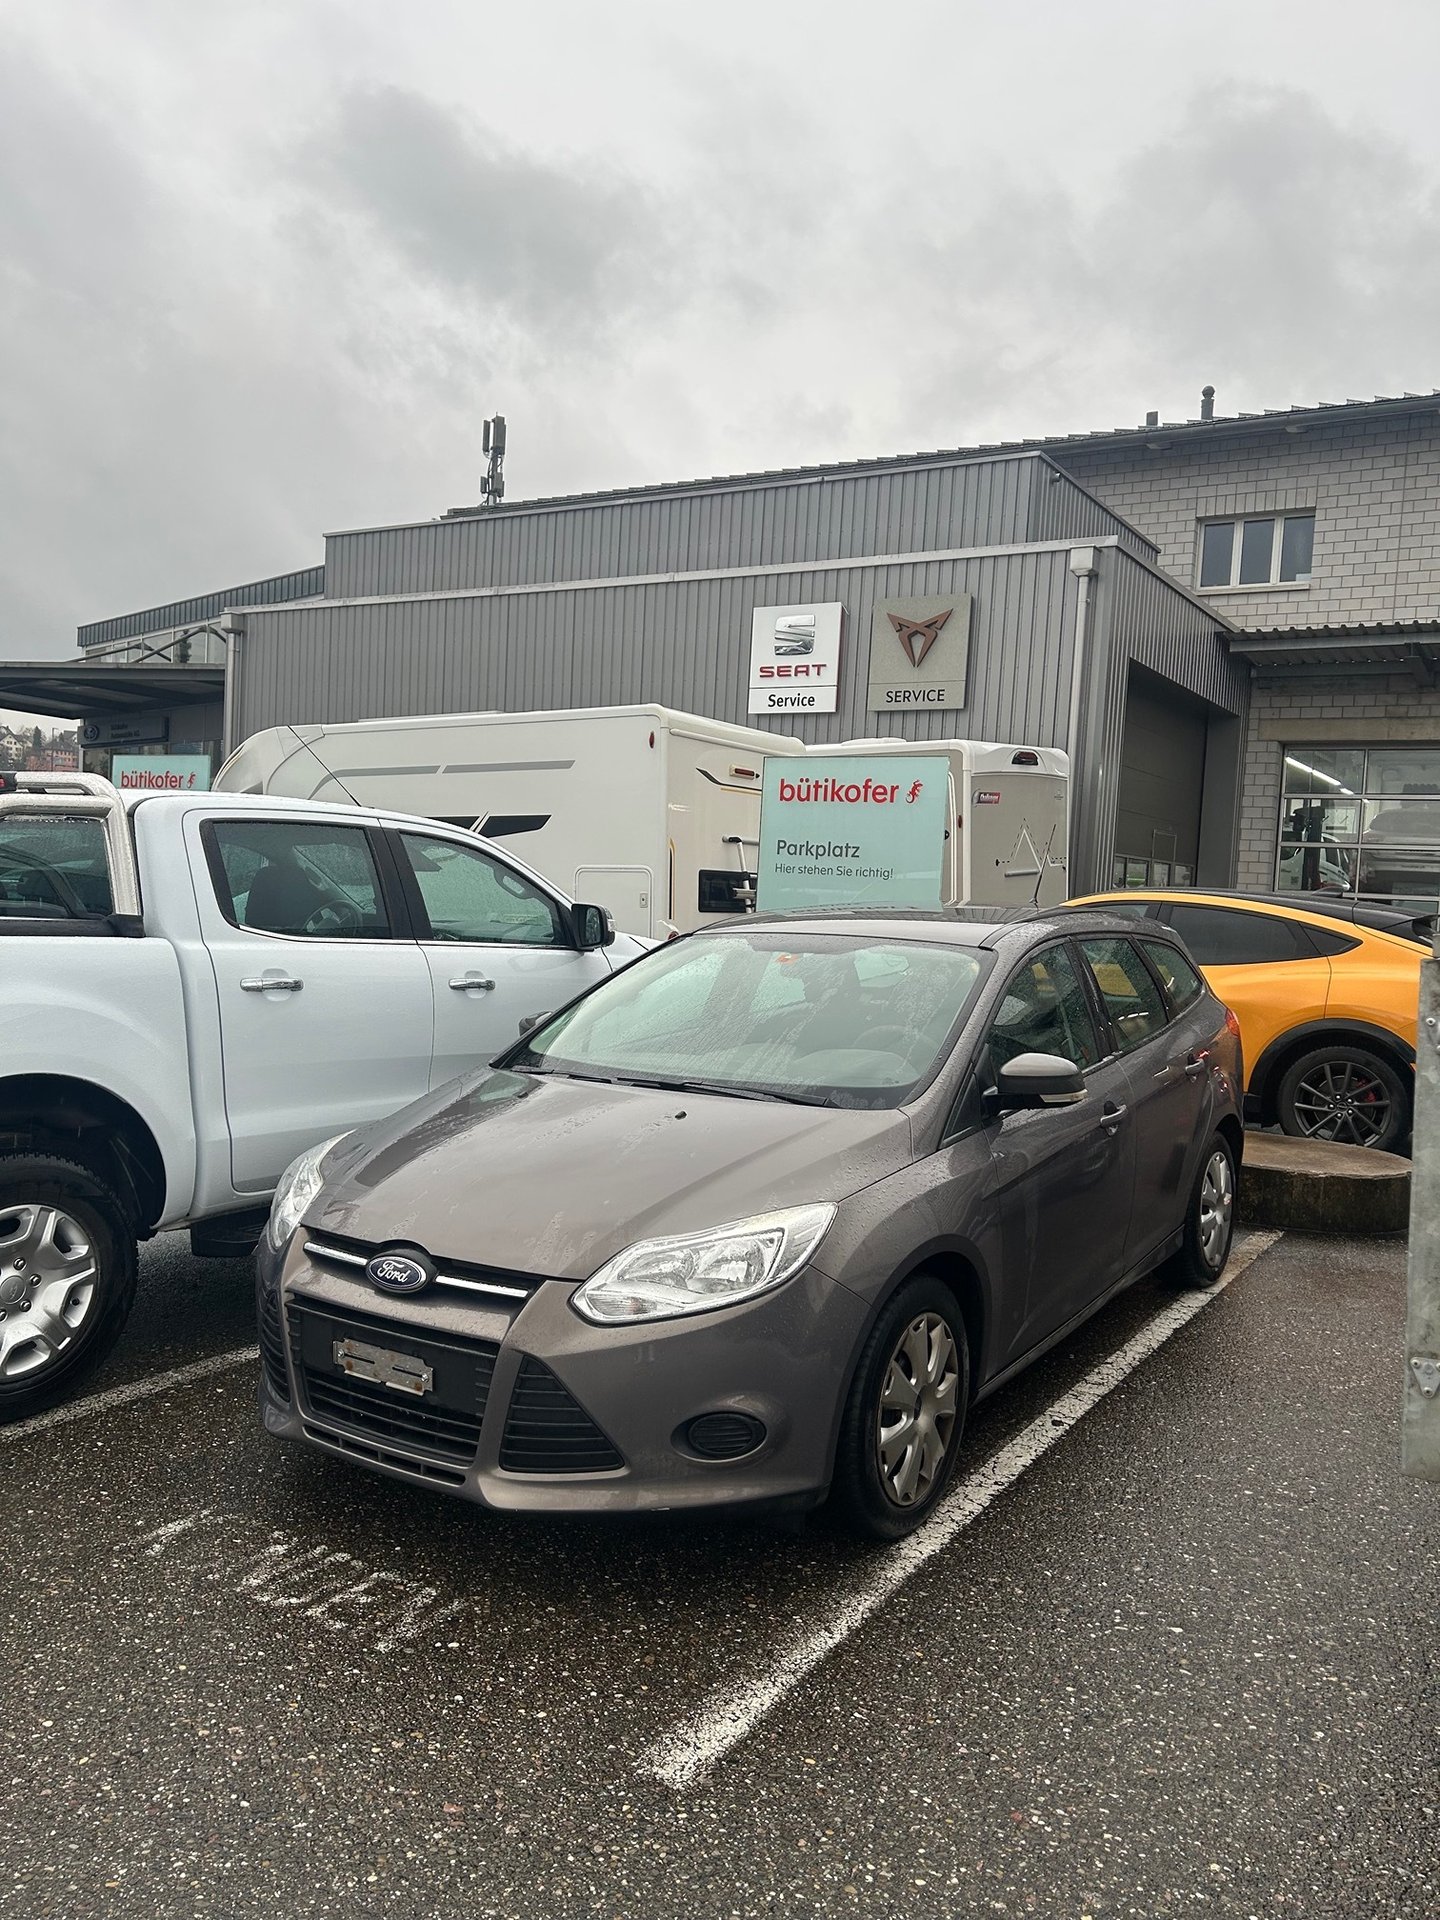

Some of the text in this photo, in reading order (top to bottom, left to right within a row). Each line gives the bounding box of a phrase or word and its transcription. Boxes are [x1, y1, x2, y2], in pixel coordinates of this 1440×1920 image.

[759, 663, 827, 678] SEAT
[767, 692, 816, 708] Service
[885, 689, 946, 703] SERVICE
[120, 771, 183, 789] bütikofer
[778, 778, 900, 804] bütikofer
[776, 839, 860, 860] Parkplatz
[774, 863, 893, 880] Hier stehen Sie richtig!
[376, 1259, 411, 1283] Ford
